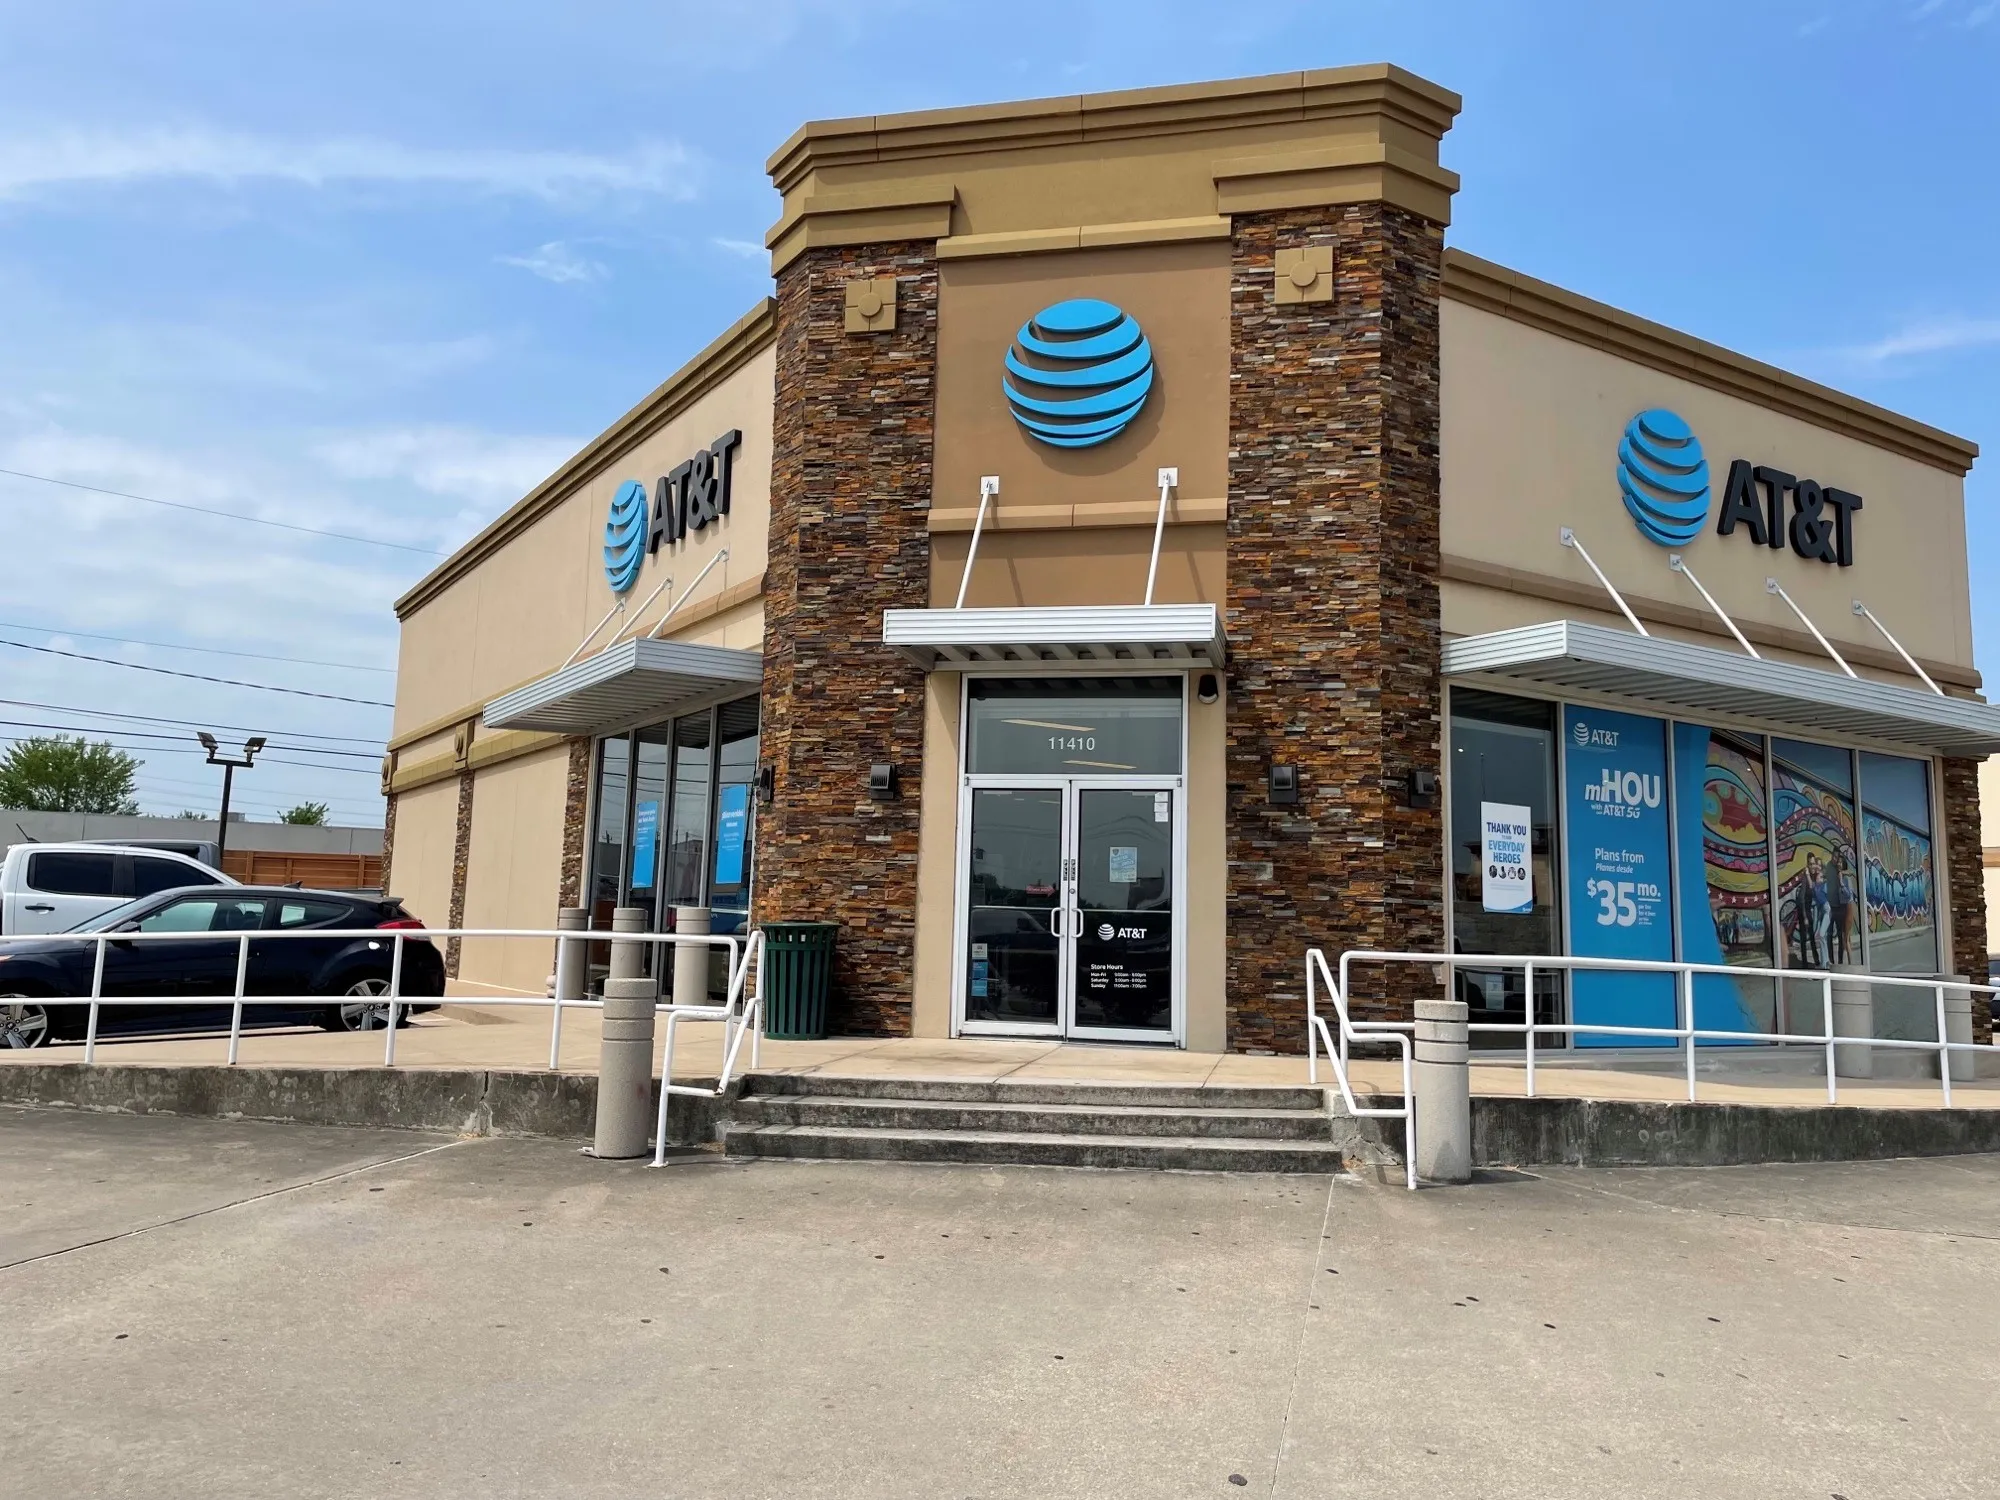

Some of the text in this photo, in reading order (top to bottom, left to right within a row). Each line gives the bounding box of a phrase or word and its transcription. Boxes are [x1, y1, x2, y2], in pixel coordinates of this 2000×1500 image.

[646, 429, 742, 553] AT&T
[1717, 459, 1862, 566] AT&T
[1048, 737, 1095, 750] 11410
[1591, 729, 1619, 746] AT&T
[1603, 804, 1625, 817] AT&T
[1626, 807, 1640, 819] 5G
[1486, 822, 1527, 836] THANK YOU
[1488, 839, 1525, 853] EVERYDAY
[1493, 851, 1521, 864] HEROES
[1595, 847, 1645, 864] Plans from
[1596, 862, 1634, 874] Planes desde
[1637, 883, 1661, 897] mo.
[1117, 928, 1147, 939] AT&T
